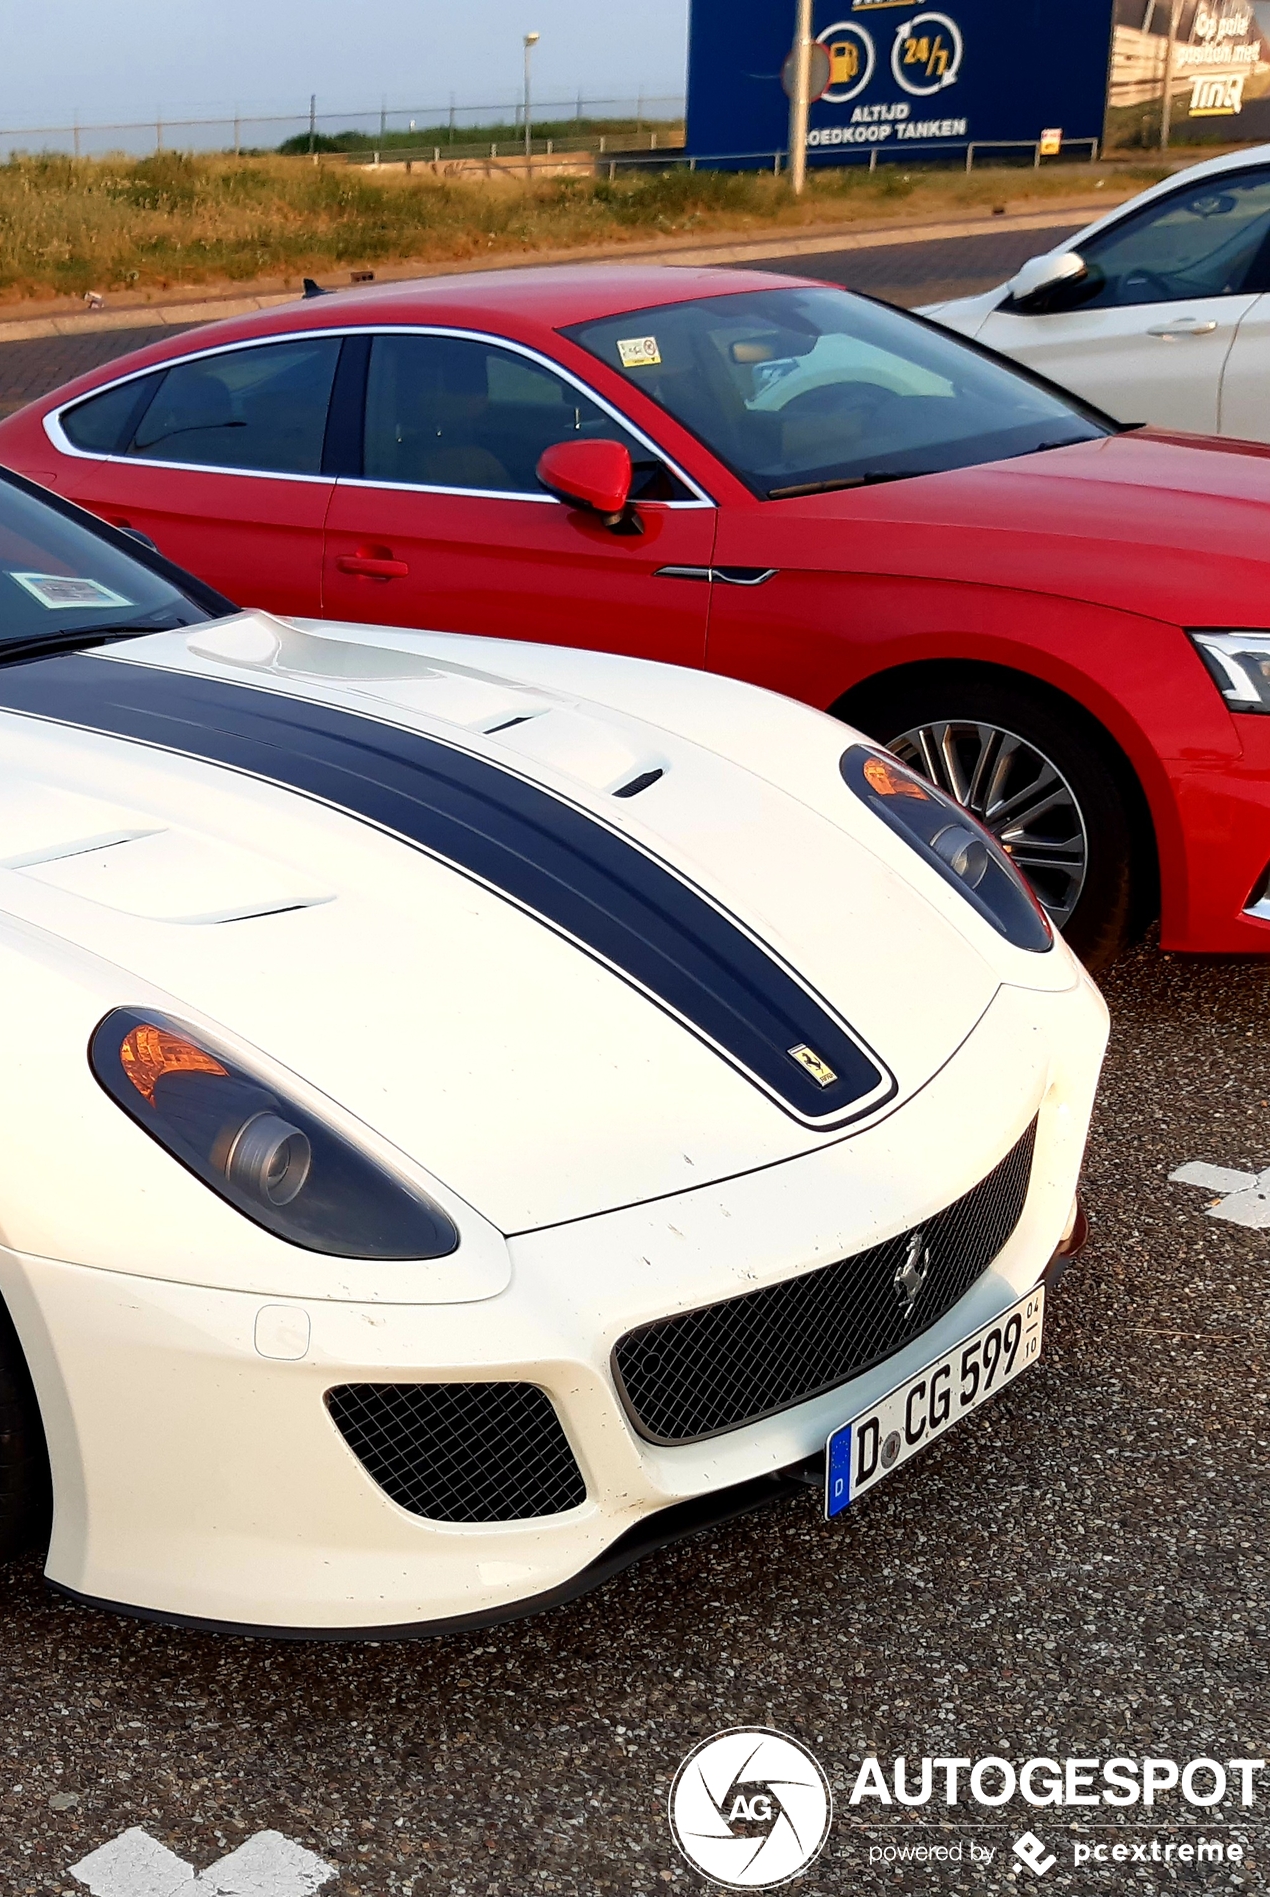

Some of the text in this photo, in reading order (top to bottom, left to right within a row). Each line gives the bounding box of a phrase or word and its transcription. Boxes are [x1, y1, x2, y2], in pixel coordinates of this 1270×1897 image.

[904, 35, 949, 77] 24/7
[851, 102, 911, 123] ALTIJD
[895, 117, 968, 140] TANKEN
[1027, 1297, 1038, 1319] 04
[1026, 1336, 1037, 1358] 10
[855, 1312, 1022, 1488] D CG 599
[834, 1478, 843, 1497] D
